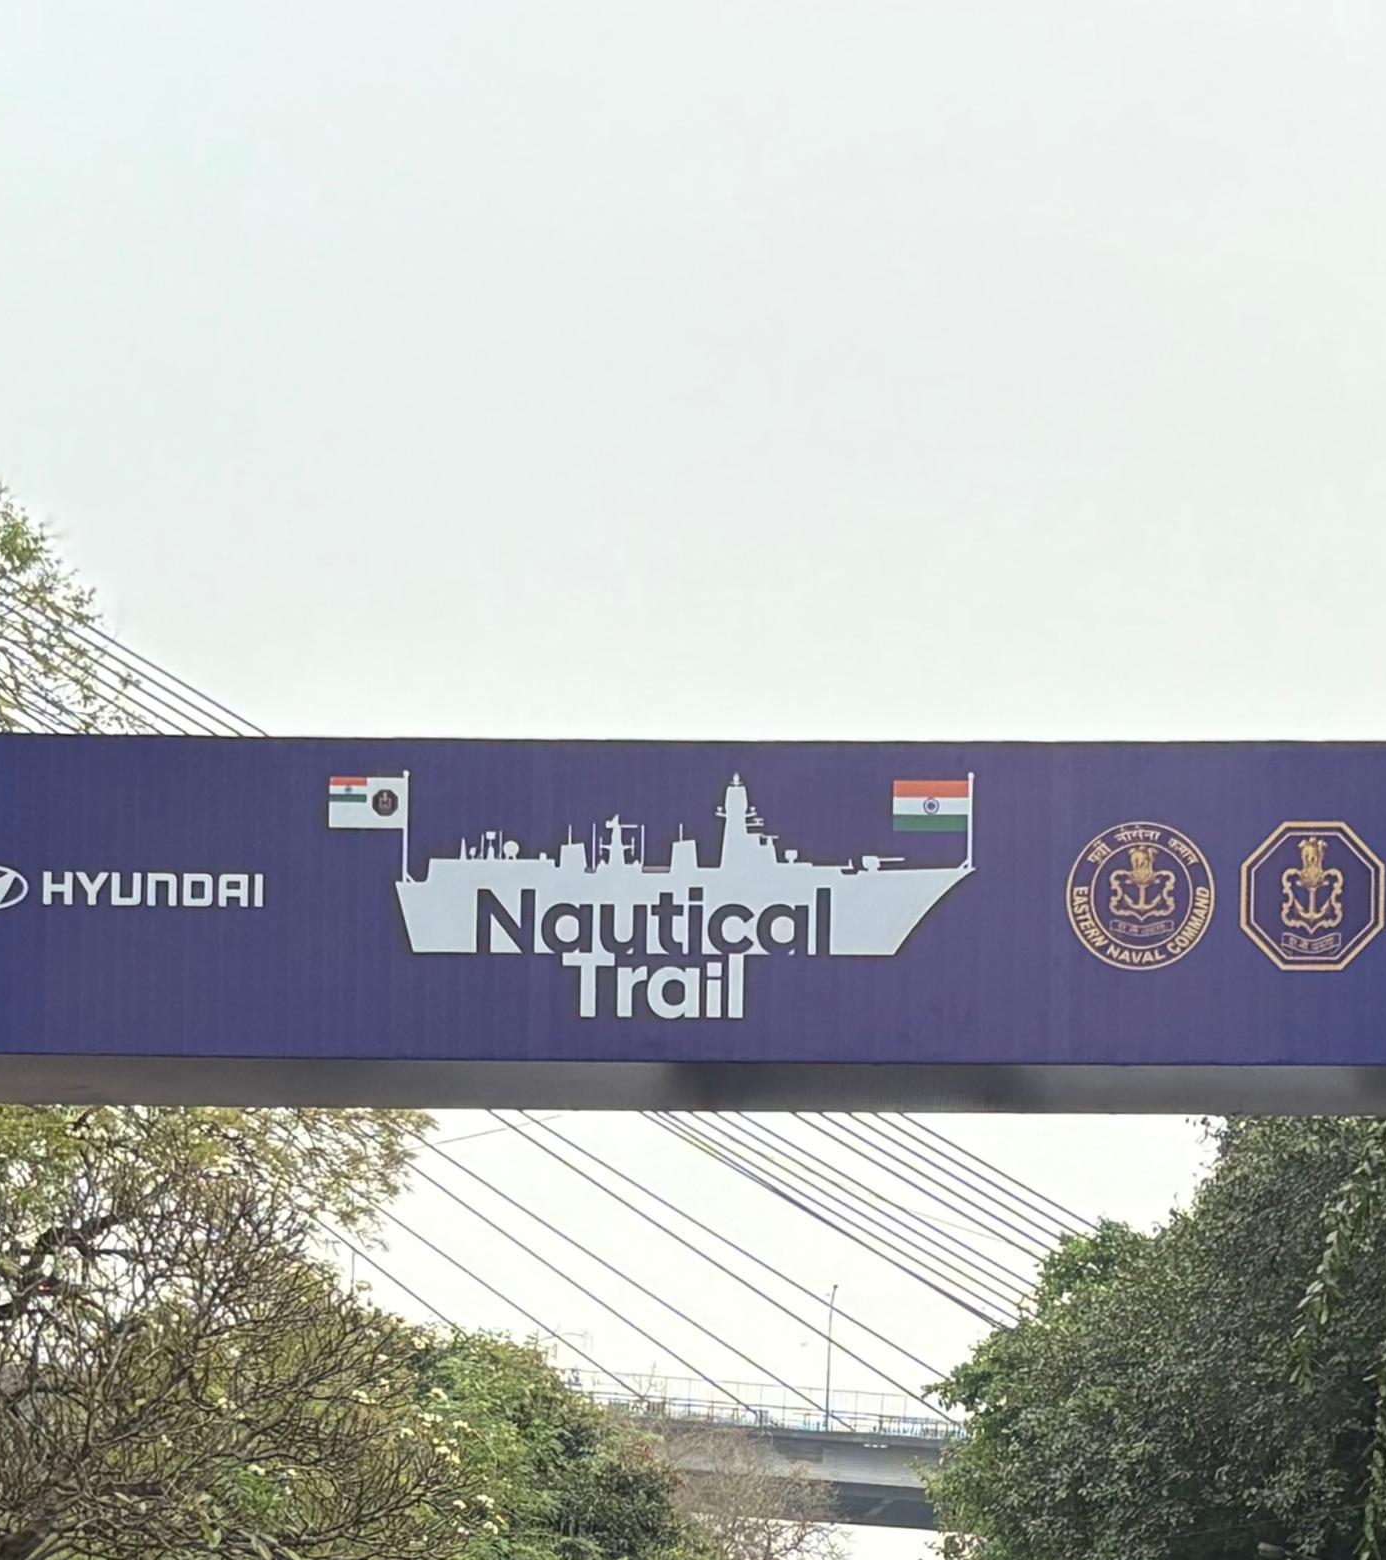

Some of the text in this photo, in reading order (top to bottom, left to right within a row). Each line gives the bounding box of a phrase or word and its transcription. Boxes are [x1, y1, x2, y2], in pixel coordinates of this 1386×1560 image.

[42, 871, 264, 908] HYUNDAI
[476, 886, 831, 955] Nautical
[1073, 886, 1210, 963] EASTERN NAVAL COMMAND
[562, 953, 744, 1018] Trail
